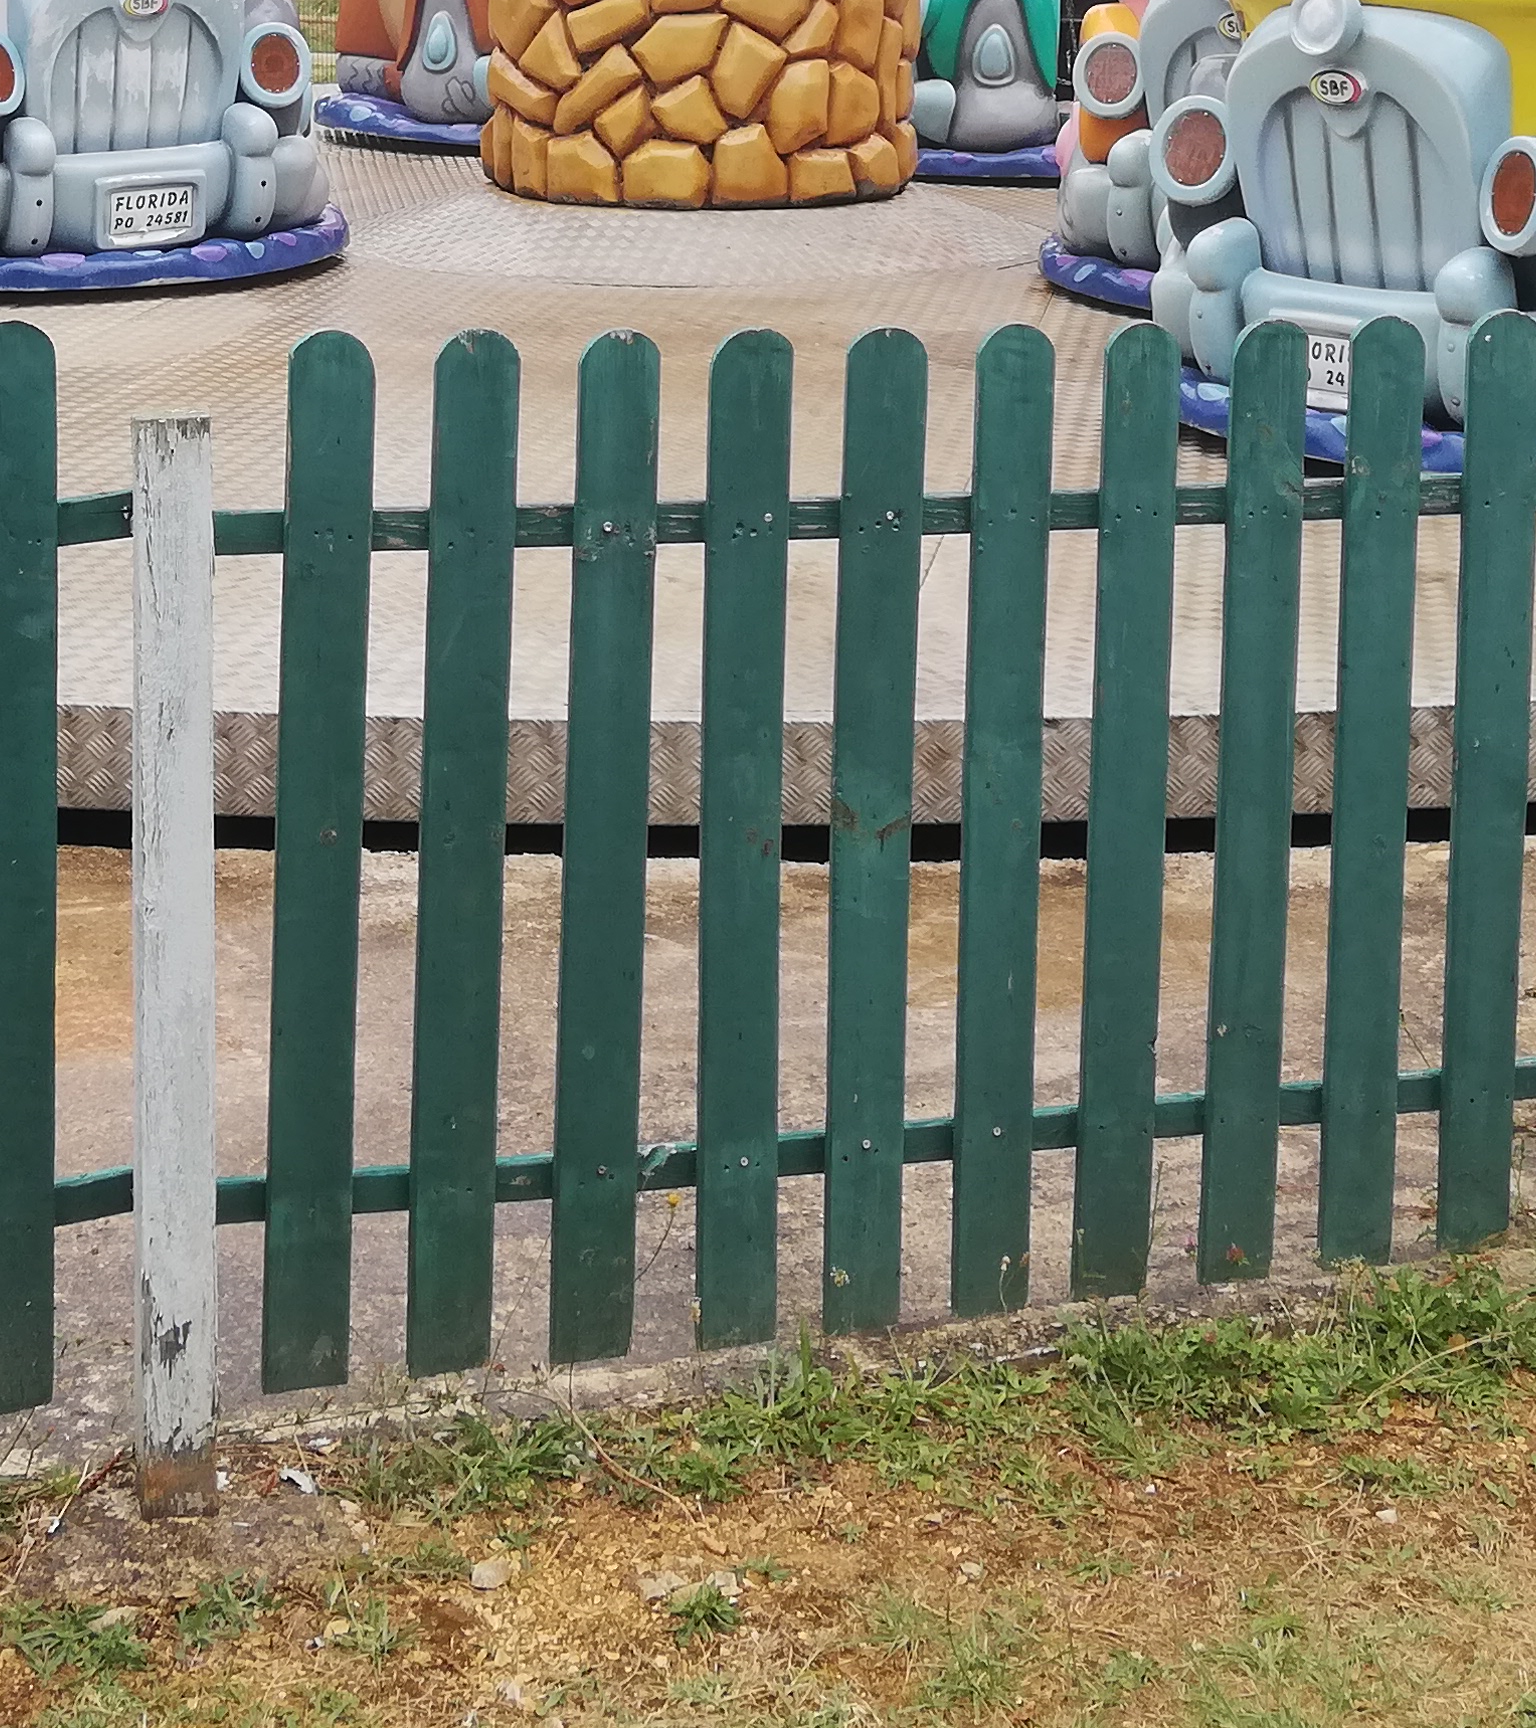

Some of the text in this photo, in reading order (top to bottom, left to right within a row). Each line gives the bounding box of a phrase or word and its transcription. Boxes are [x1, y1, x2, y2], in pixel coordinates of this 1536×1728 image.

[1319, 79, 1349, 96] SBF
[115, 190, 189, 212] FLORIDA
[146, 210, 188, 227] 24581
[1311, 341, 1345, 364] ORI
[1326, 369, 1345, 387] 24
